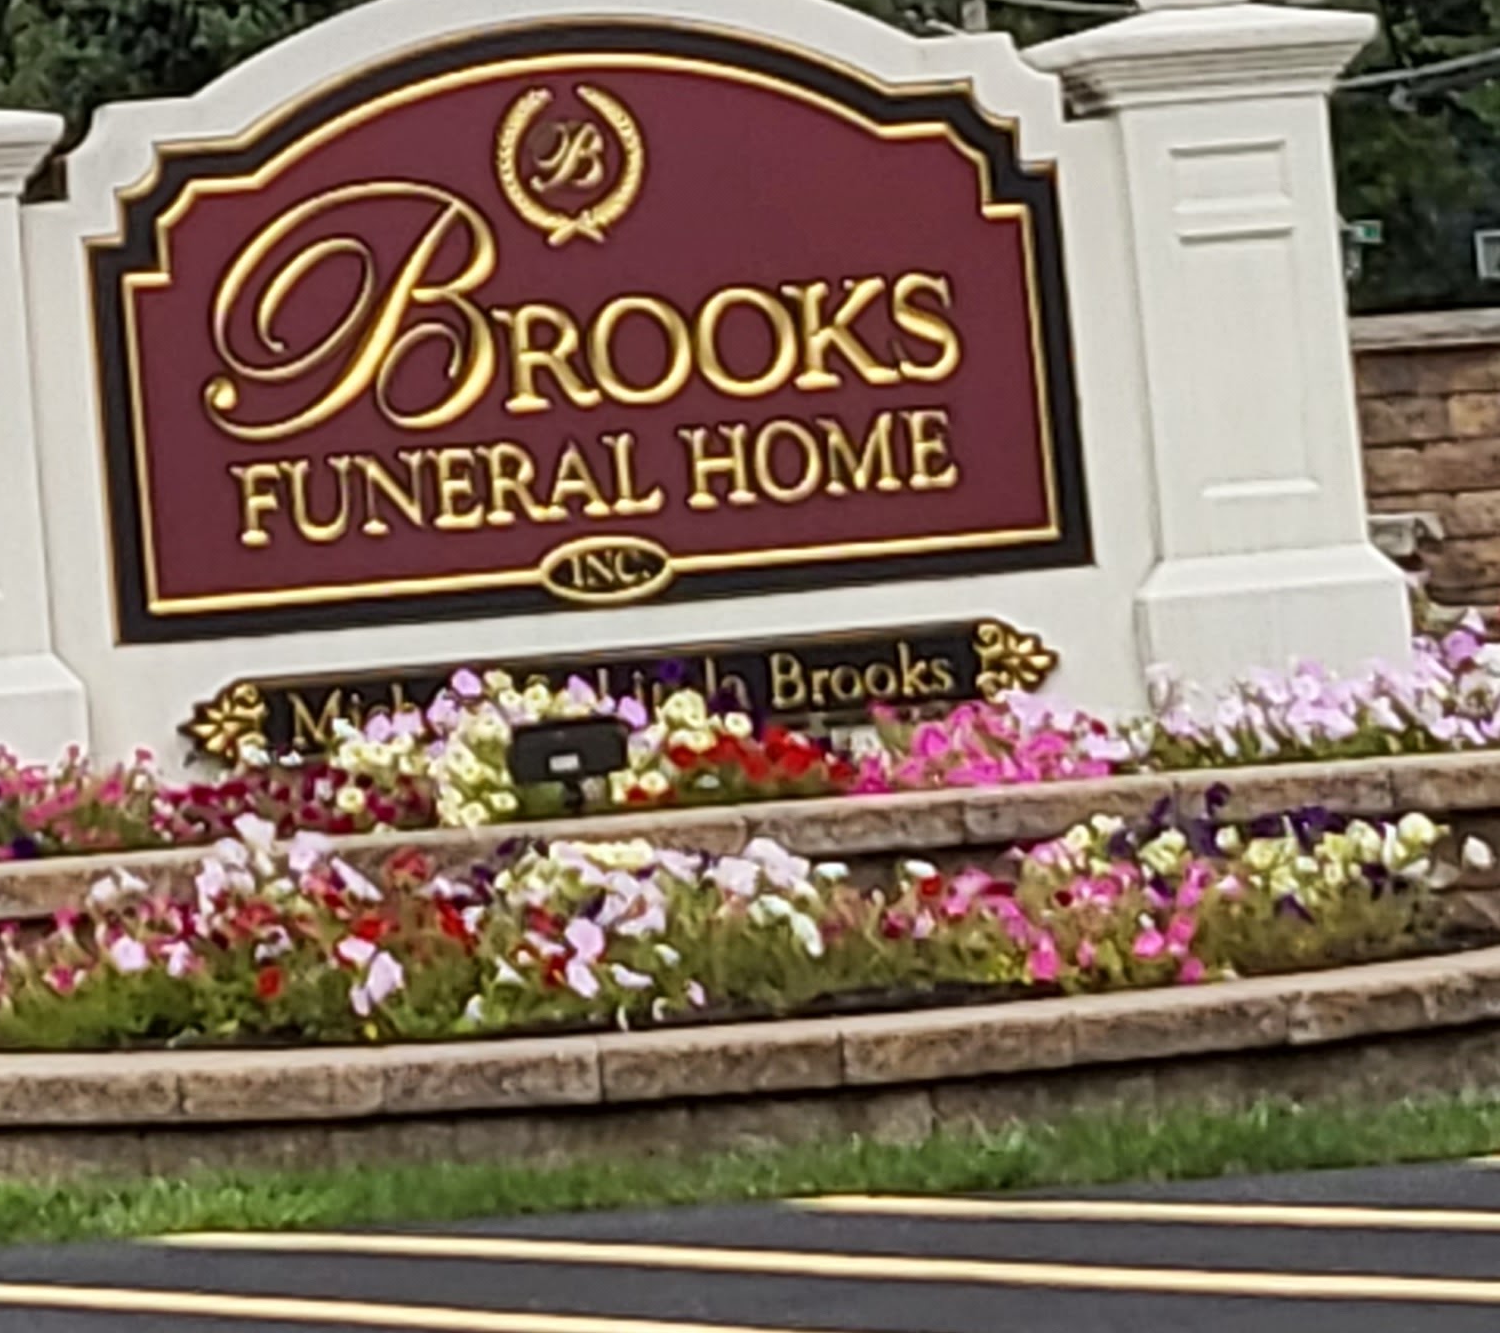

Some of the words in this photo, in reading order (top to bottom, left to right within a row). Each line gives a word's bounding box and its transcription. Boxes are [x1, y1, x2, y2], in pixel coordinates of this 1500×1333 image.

[529, 119, 605, 193] B
[205, 182, 960, 438] BROOKS
[230, 434, 665, 546] FUNERAL
[679, 410, 959, 510] HOME
[571, 546, 651, 587] INC.
[769, 641, 954, 709] Brooks
